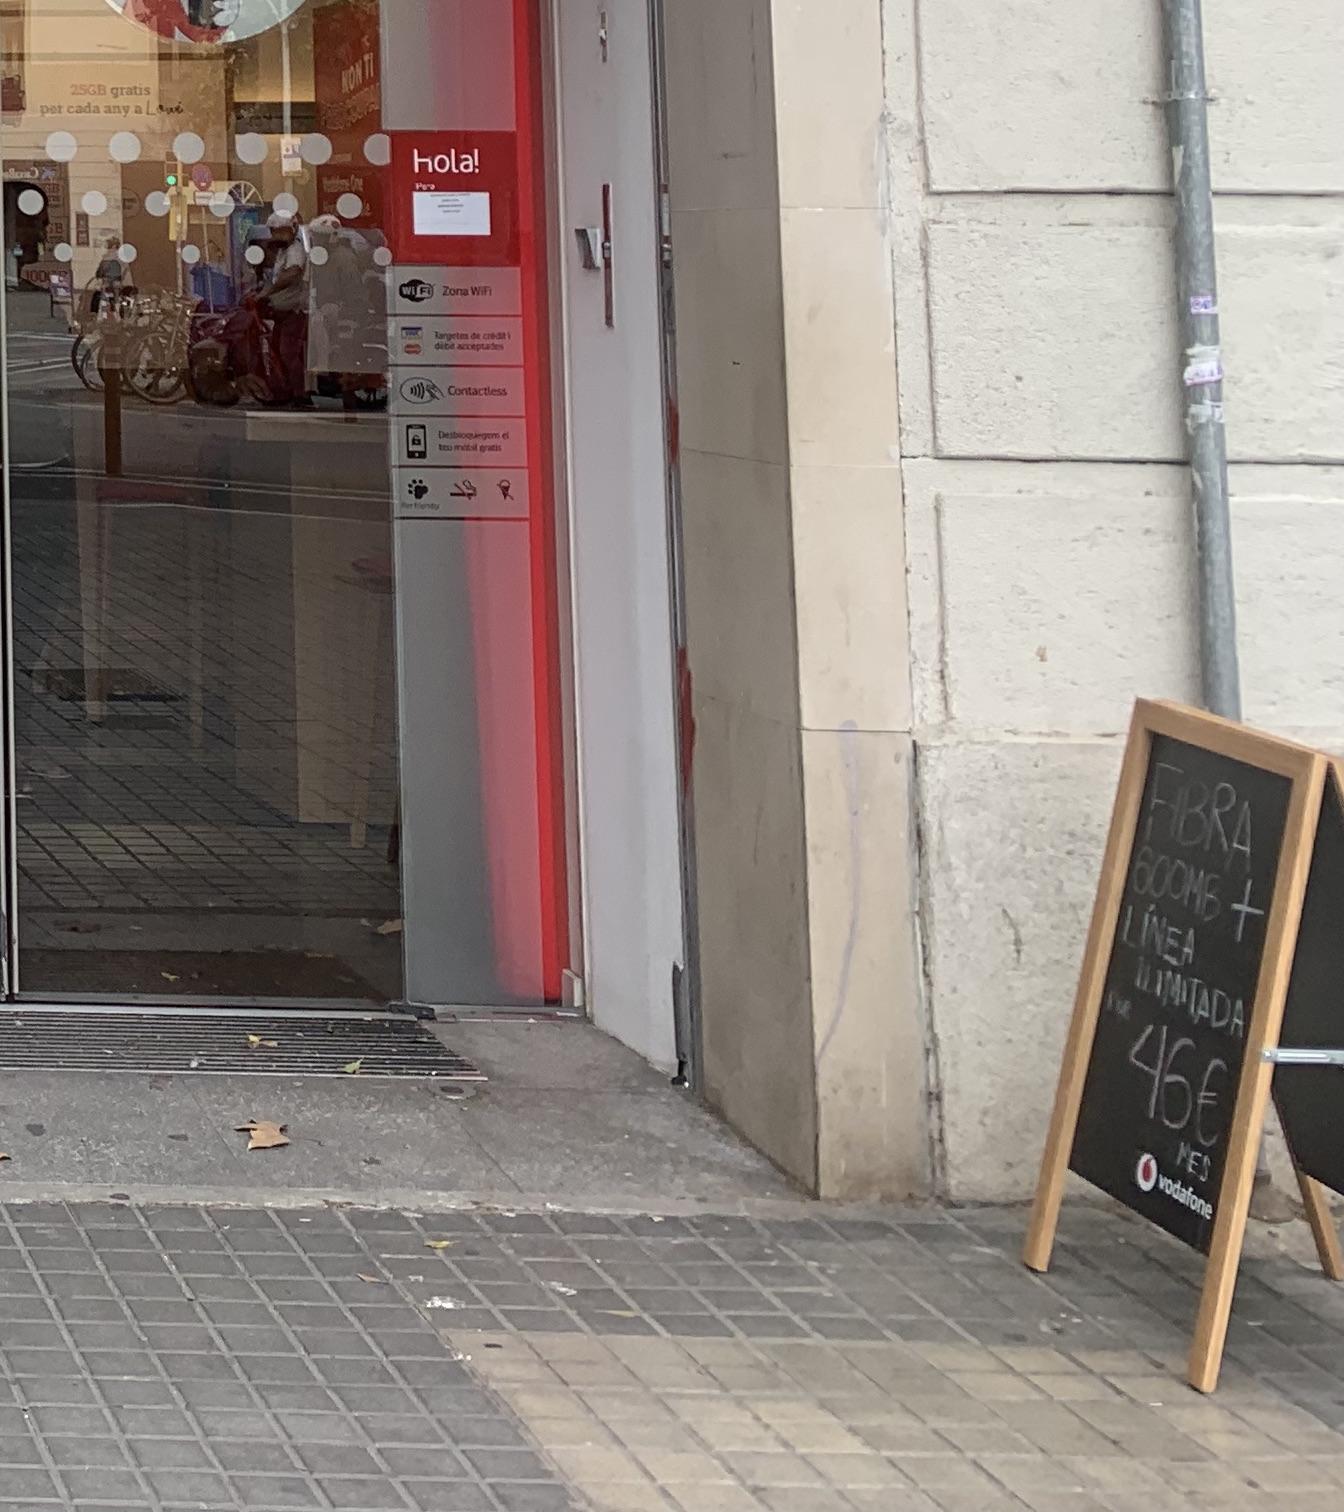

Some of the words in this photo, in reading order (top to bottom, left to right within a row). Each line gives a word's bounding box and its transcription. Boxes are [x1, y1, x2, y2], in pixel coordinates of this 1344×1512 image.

[110, 83, 151, 98] gratis
[40, 103, 63, 116] per
[66, 102, 100, 114] cada
[104, 104, 131, 117] any
[135, 106, 143, 115] a
[443, 286, 469, 296] Zona
[470, 286, 492, 296] WiFi
[447, 386, 508, 397] Contactless
[1129, 1024, 1228, 1147] 46€
[1158, 1173, 1213, 1221] vodafone
